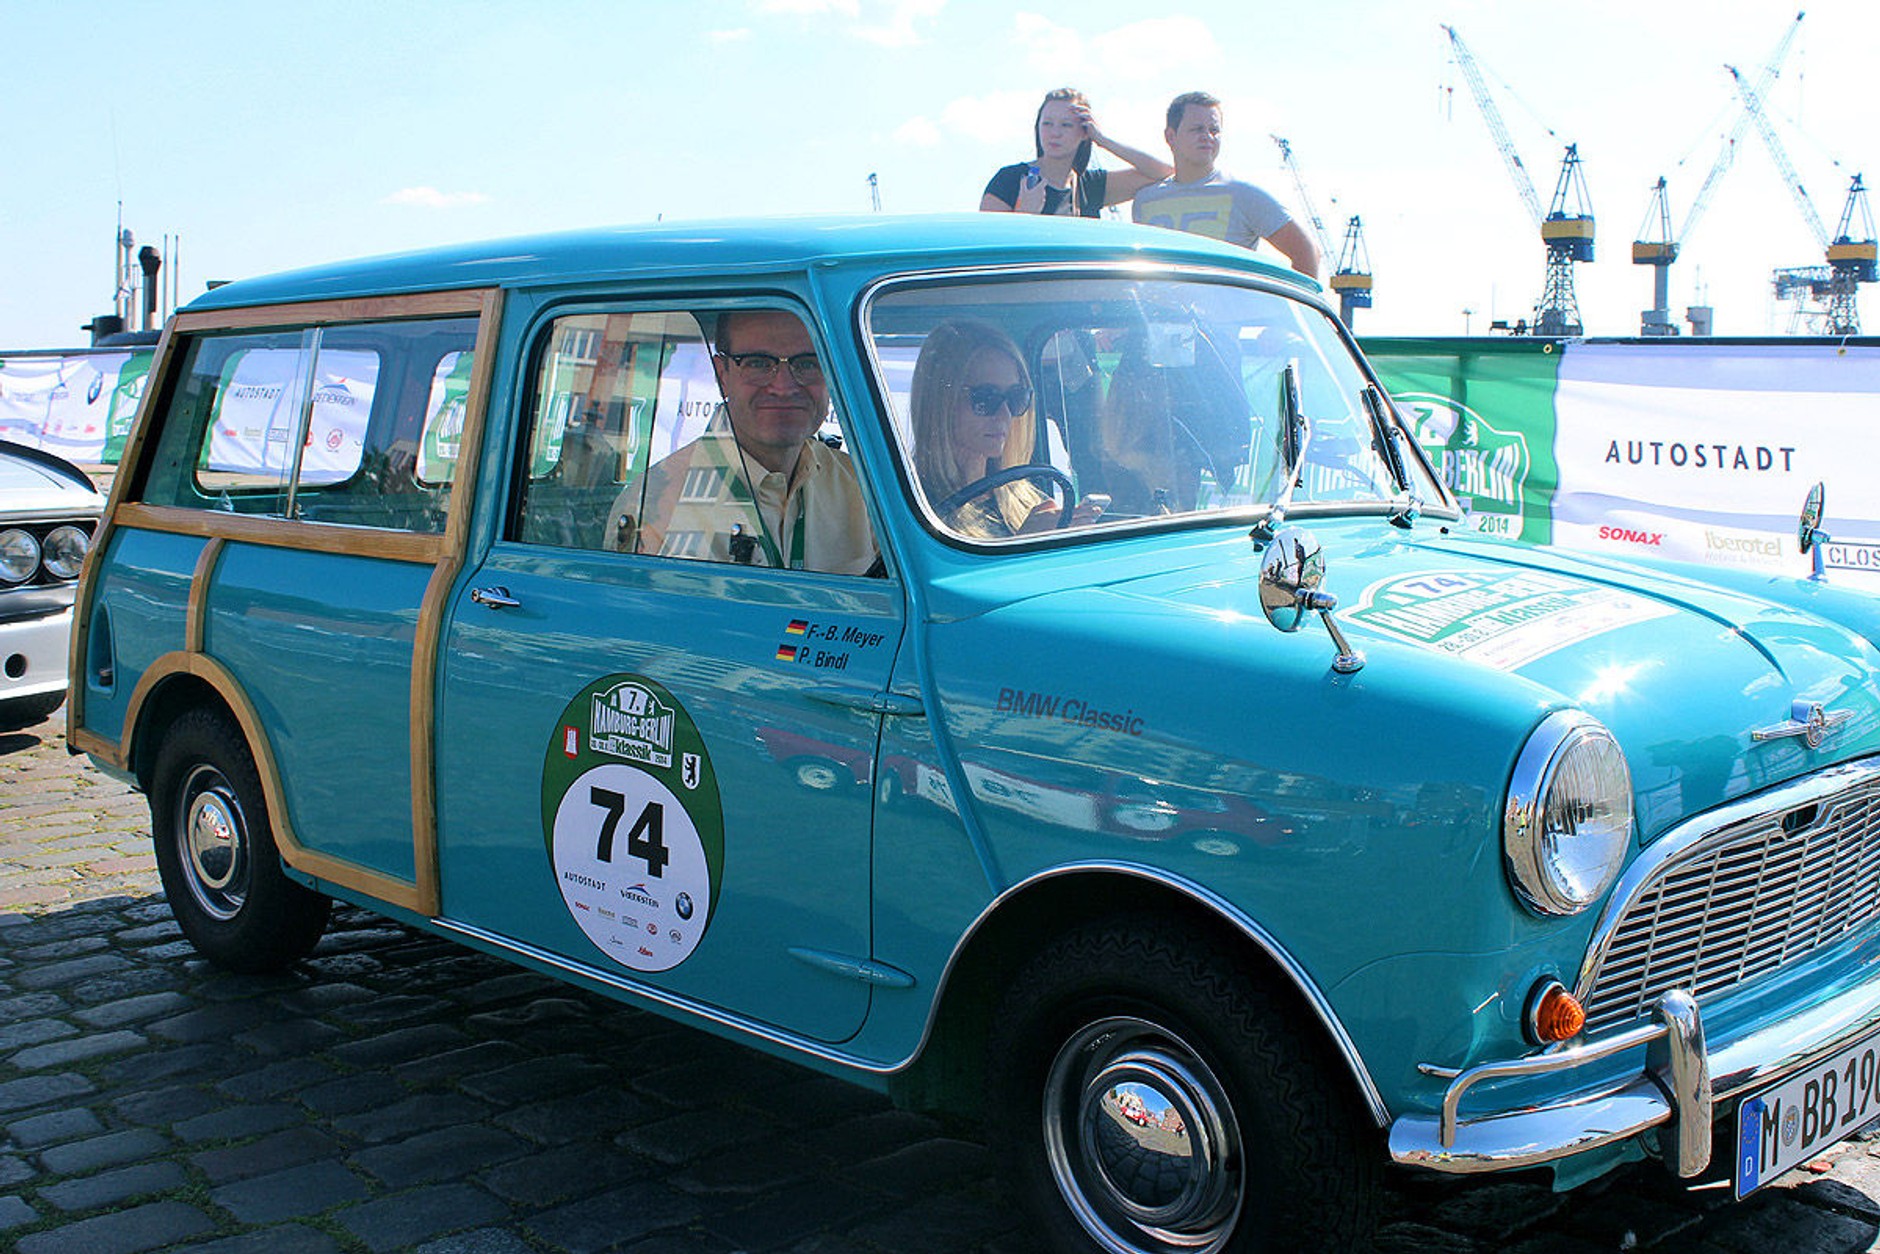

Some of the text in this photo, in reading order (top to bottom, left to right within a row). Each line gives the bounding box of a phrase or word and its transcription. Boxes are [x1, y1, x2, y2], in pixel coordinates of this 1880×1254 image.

[1605, 440, 1795, 471] AUTOSTADT
[1479, 515, 1509, 533] 2014
[1599, 526, 1662, 546] SONAX
[1404, 576, 1468, 594] 74
[842, 627, 885, 648] Meyer
[799, 646, 849, 670] P. Bindl
[996, 687, 1145, 736] BMW Classic
[590, 786, 669, 879] 74
[564, 871, 606, 891] AUTOSTADT
[1745, 1156, 1753, 1177] D
[1760, 1097, 1781, 1174] M
